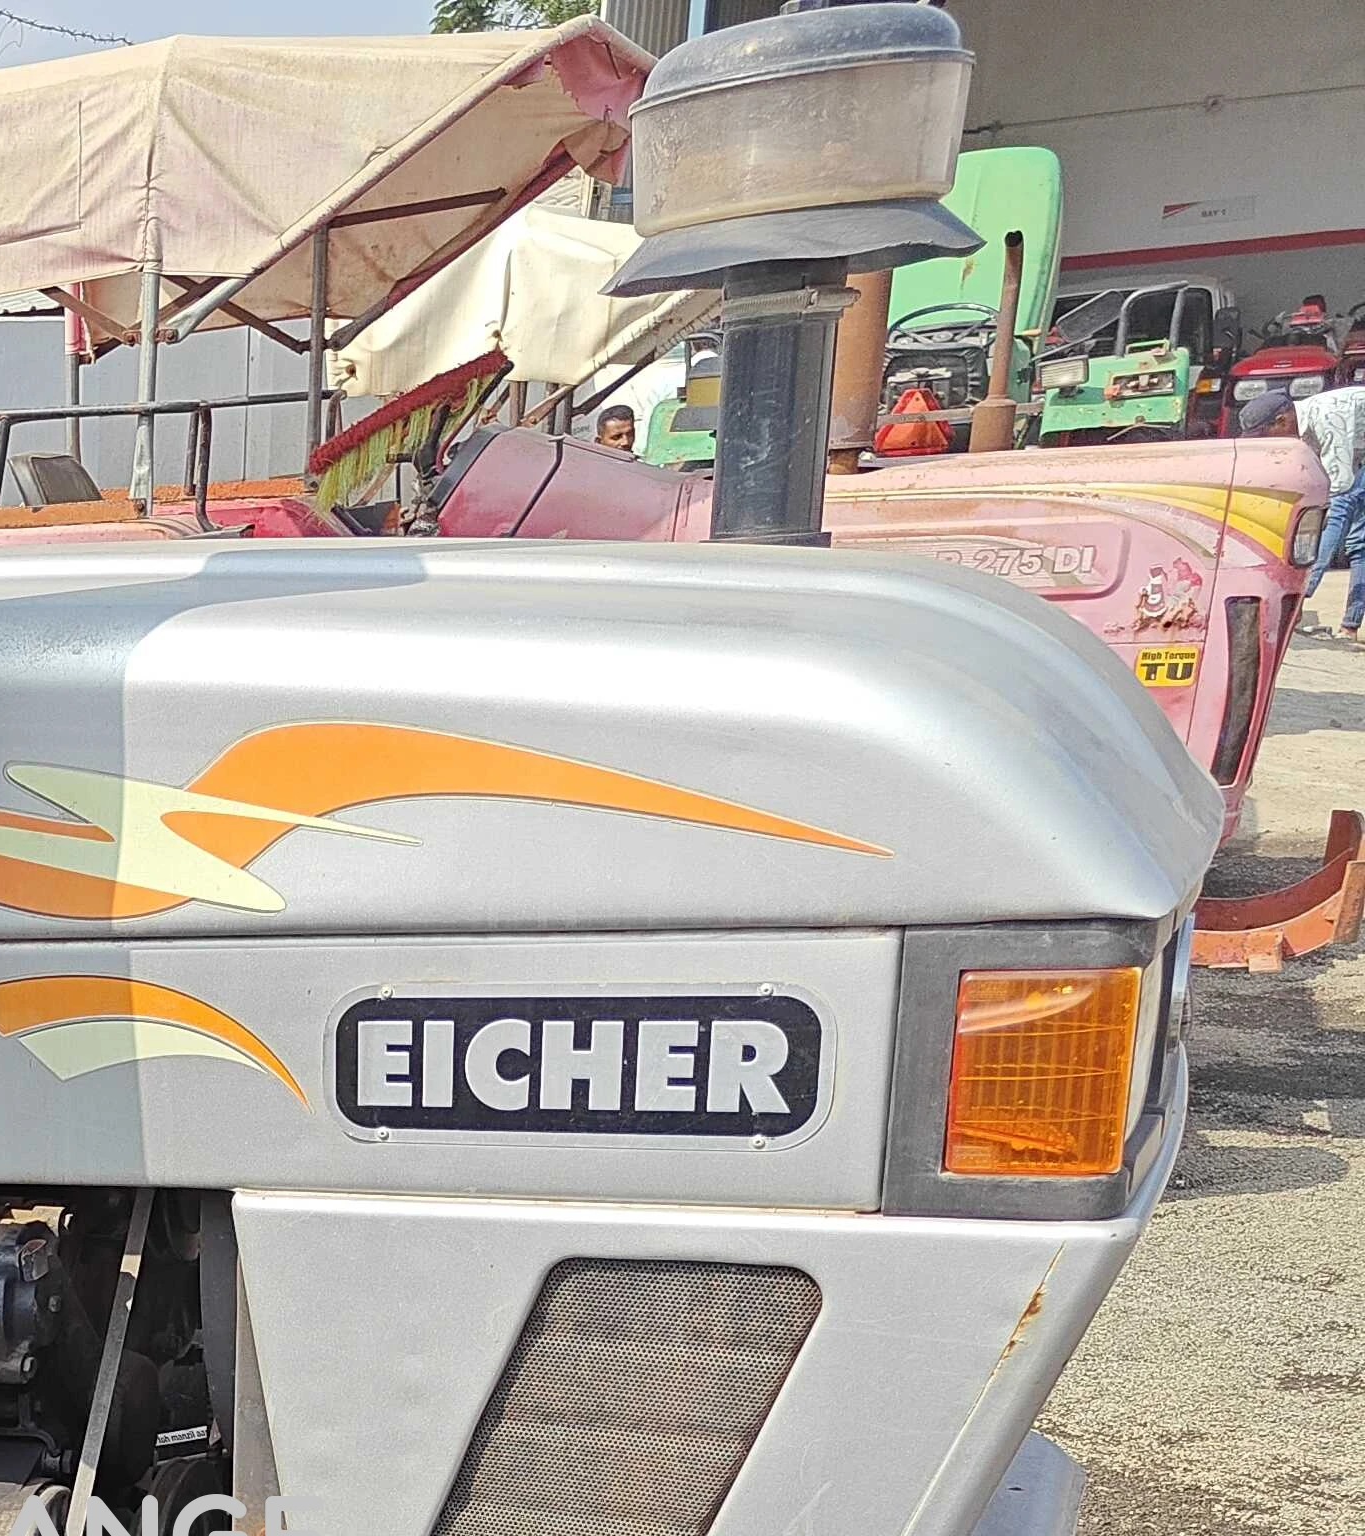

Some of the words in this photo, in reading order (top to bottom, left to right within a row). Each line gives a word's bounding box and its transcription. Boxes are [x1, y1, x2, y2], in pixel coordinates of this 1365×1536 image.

[973, 548, 1045, 577] 275
[1052, 545, 1097, 574] DI
[1141, 651, 1162, 660] High
[1164, 651, 1196, 660] Torque
[1140, 662, 1195, 681] TU
[356, 1017, 792, 1115] EICHER
